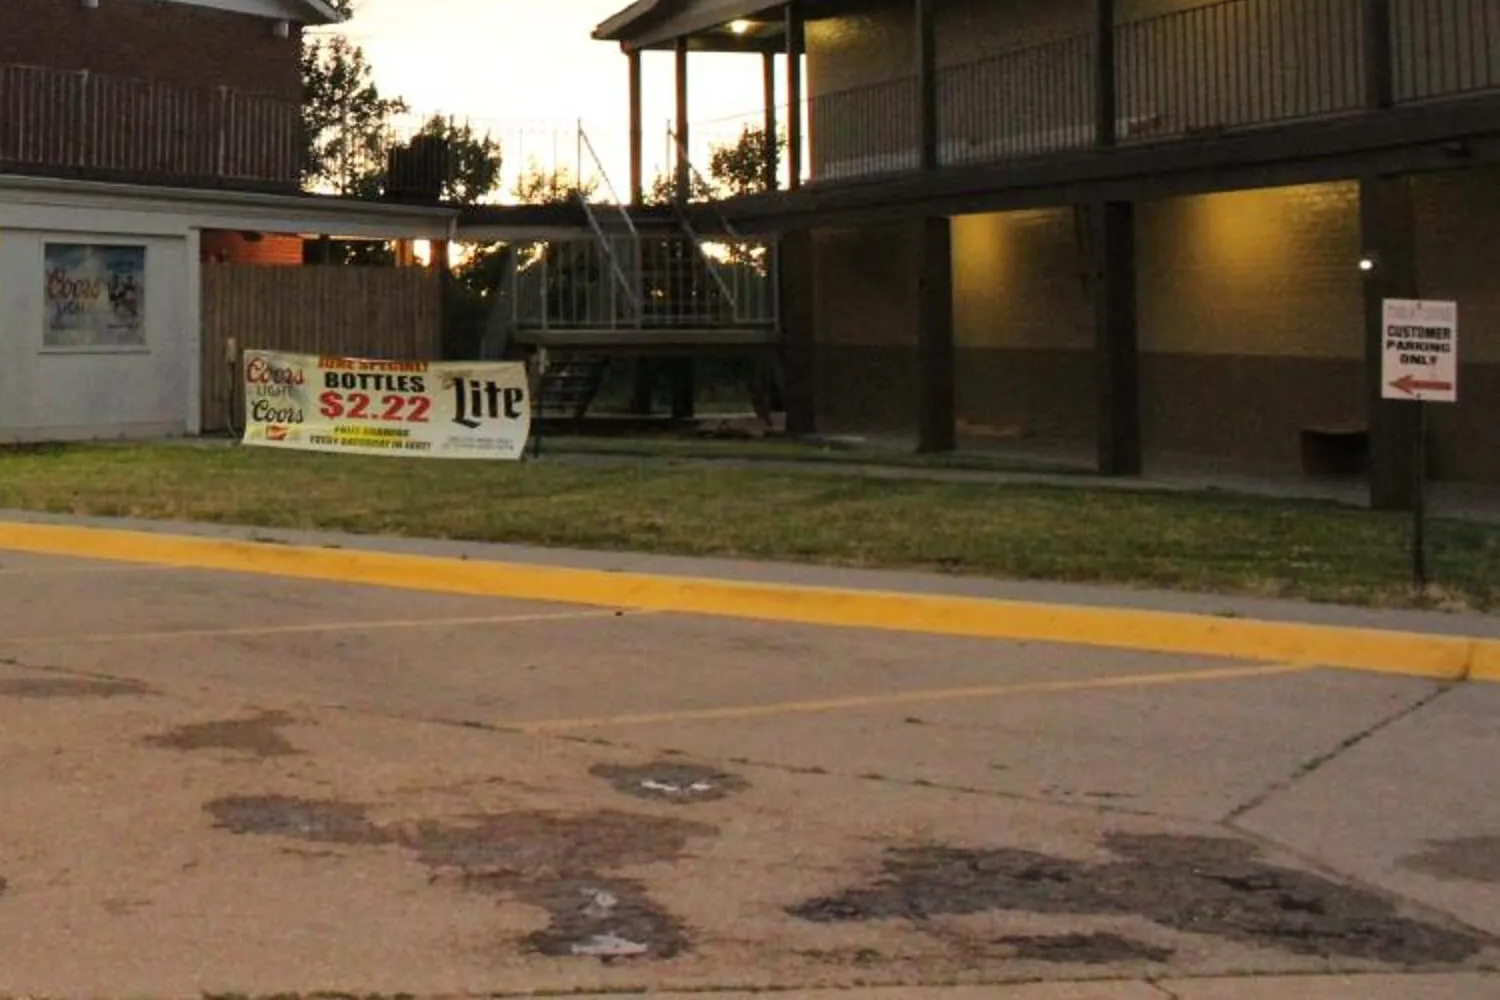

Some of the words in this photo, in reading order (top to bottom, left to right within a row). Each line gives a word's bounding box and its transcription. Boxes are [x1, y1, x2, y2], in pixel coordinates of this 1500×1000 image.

[1387, 325, 1451, 340] CUSTOMER
[1386, 340, 1451, 353] PARKING
[247, 358, 304, 385] Coors
[1399, 354, 1438, 366] ONLY
[325, 372, 425, 393] BOTTLES
[252, 399, 304, 424] Coors
[320, 391, 431, 422] $2.22
[451, 376, 523, 429] Lite
